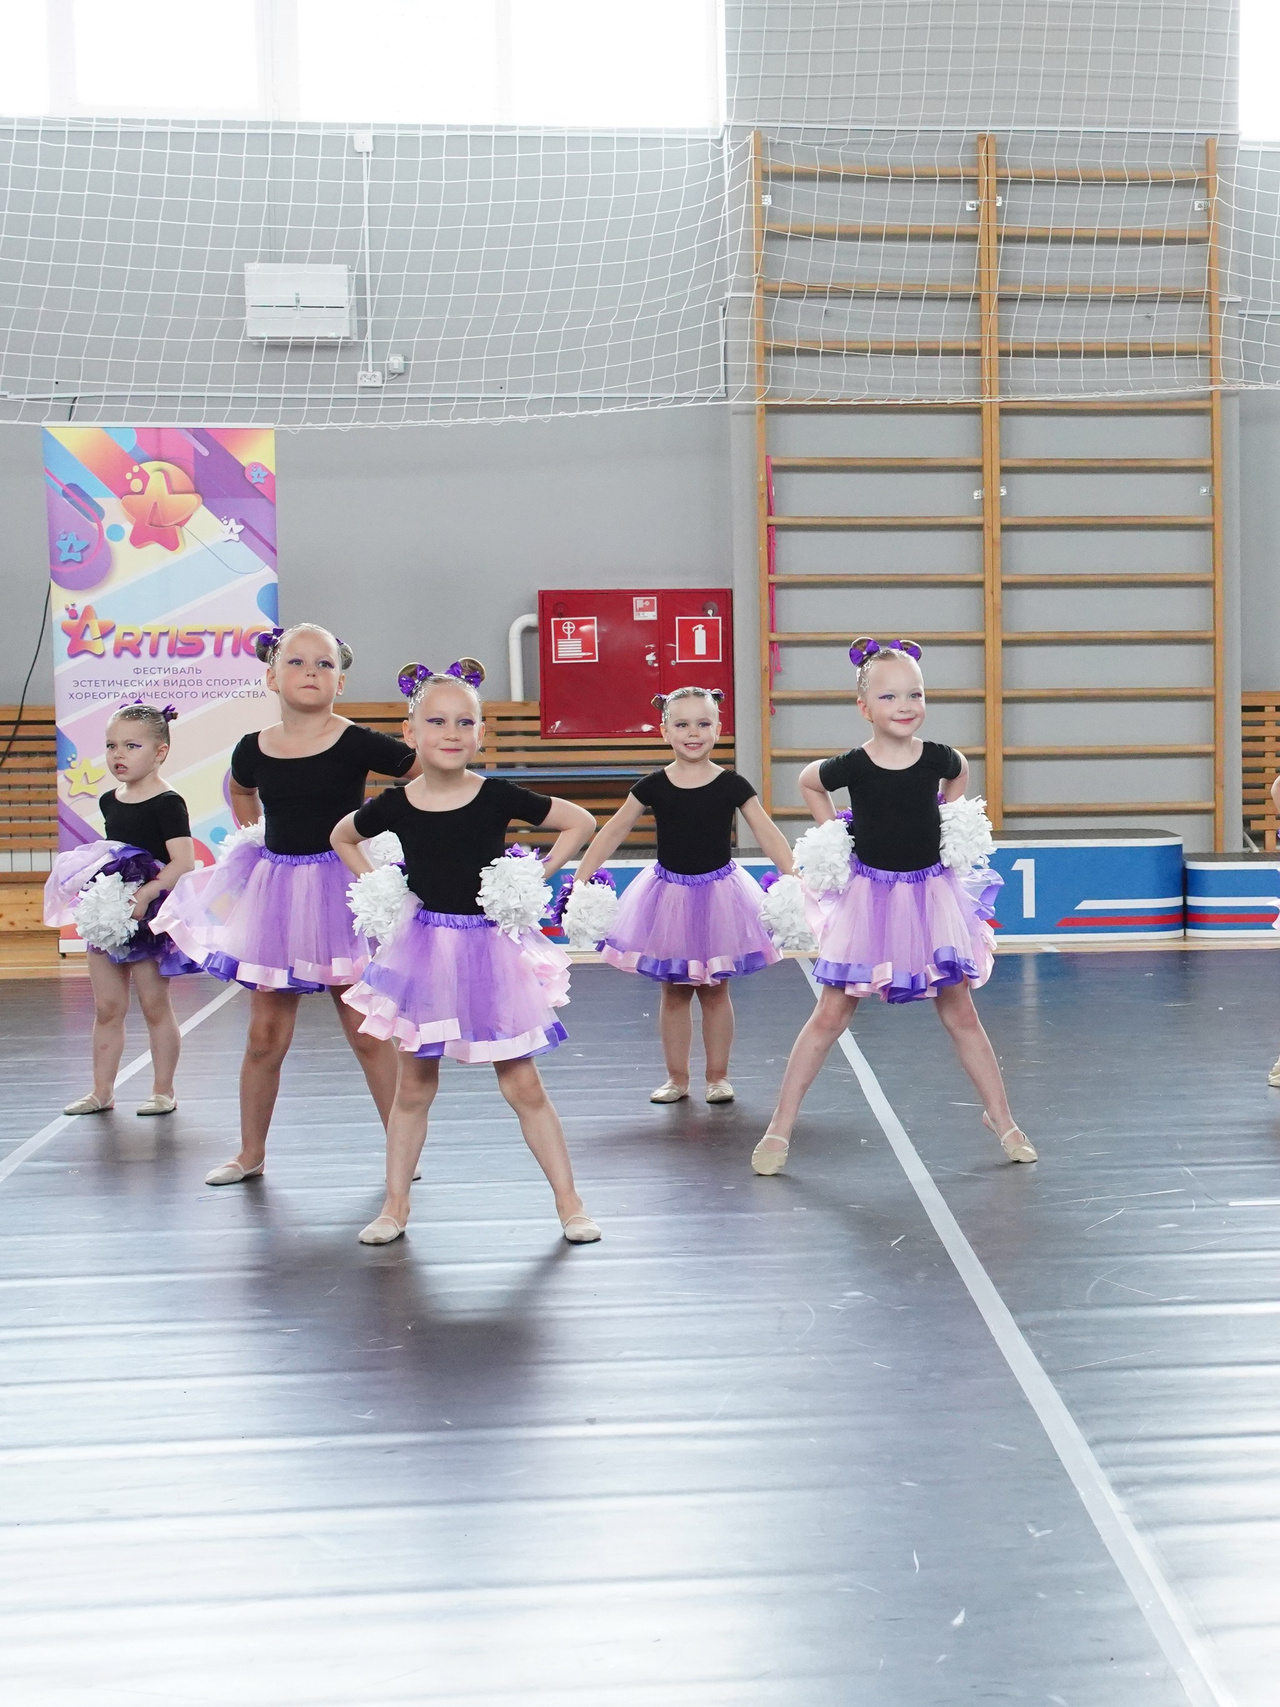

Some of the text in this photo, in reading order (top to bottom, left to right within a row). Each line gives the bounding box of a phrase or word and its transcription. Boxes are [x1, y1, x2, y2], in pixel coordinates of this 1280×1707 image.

[132, 666, 202, 675] ФЕСТИВАЛЬ
[72, 678, 262, 688] ЭСТЕТИЧЕСКИХ ВИДОВ СПОРТА И
[68, 690, 267, 700] ХОРЕОГРАФИЧЕСКОГО ИСКУССТВА
[1011, 858, 1037, 918] 1
